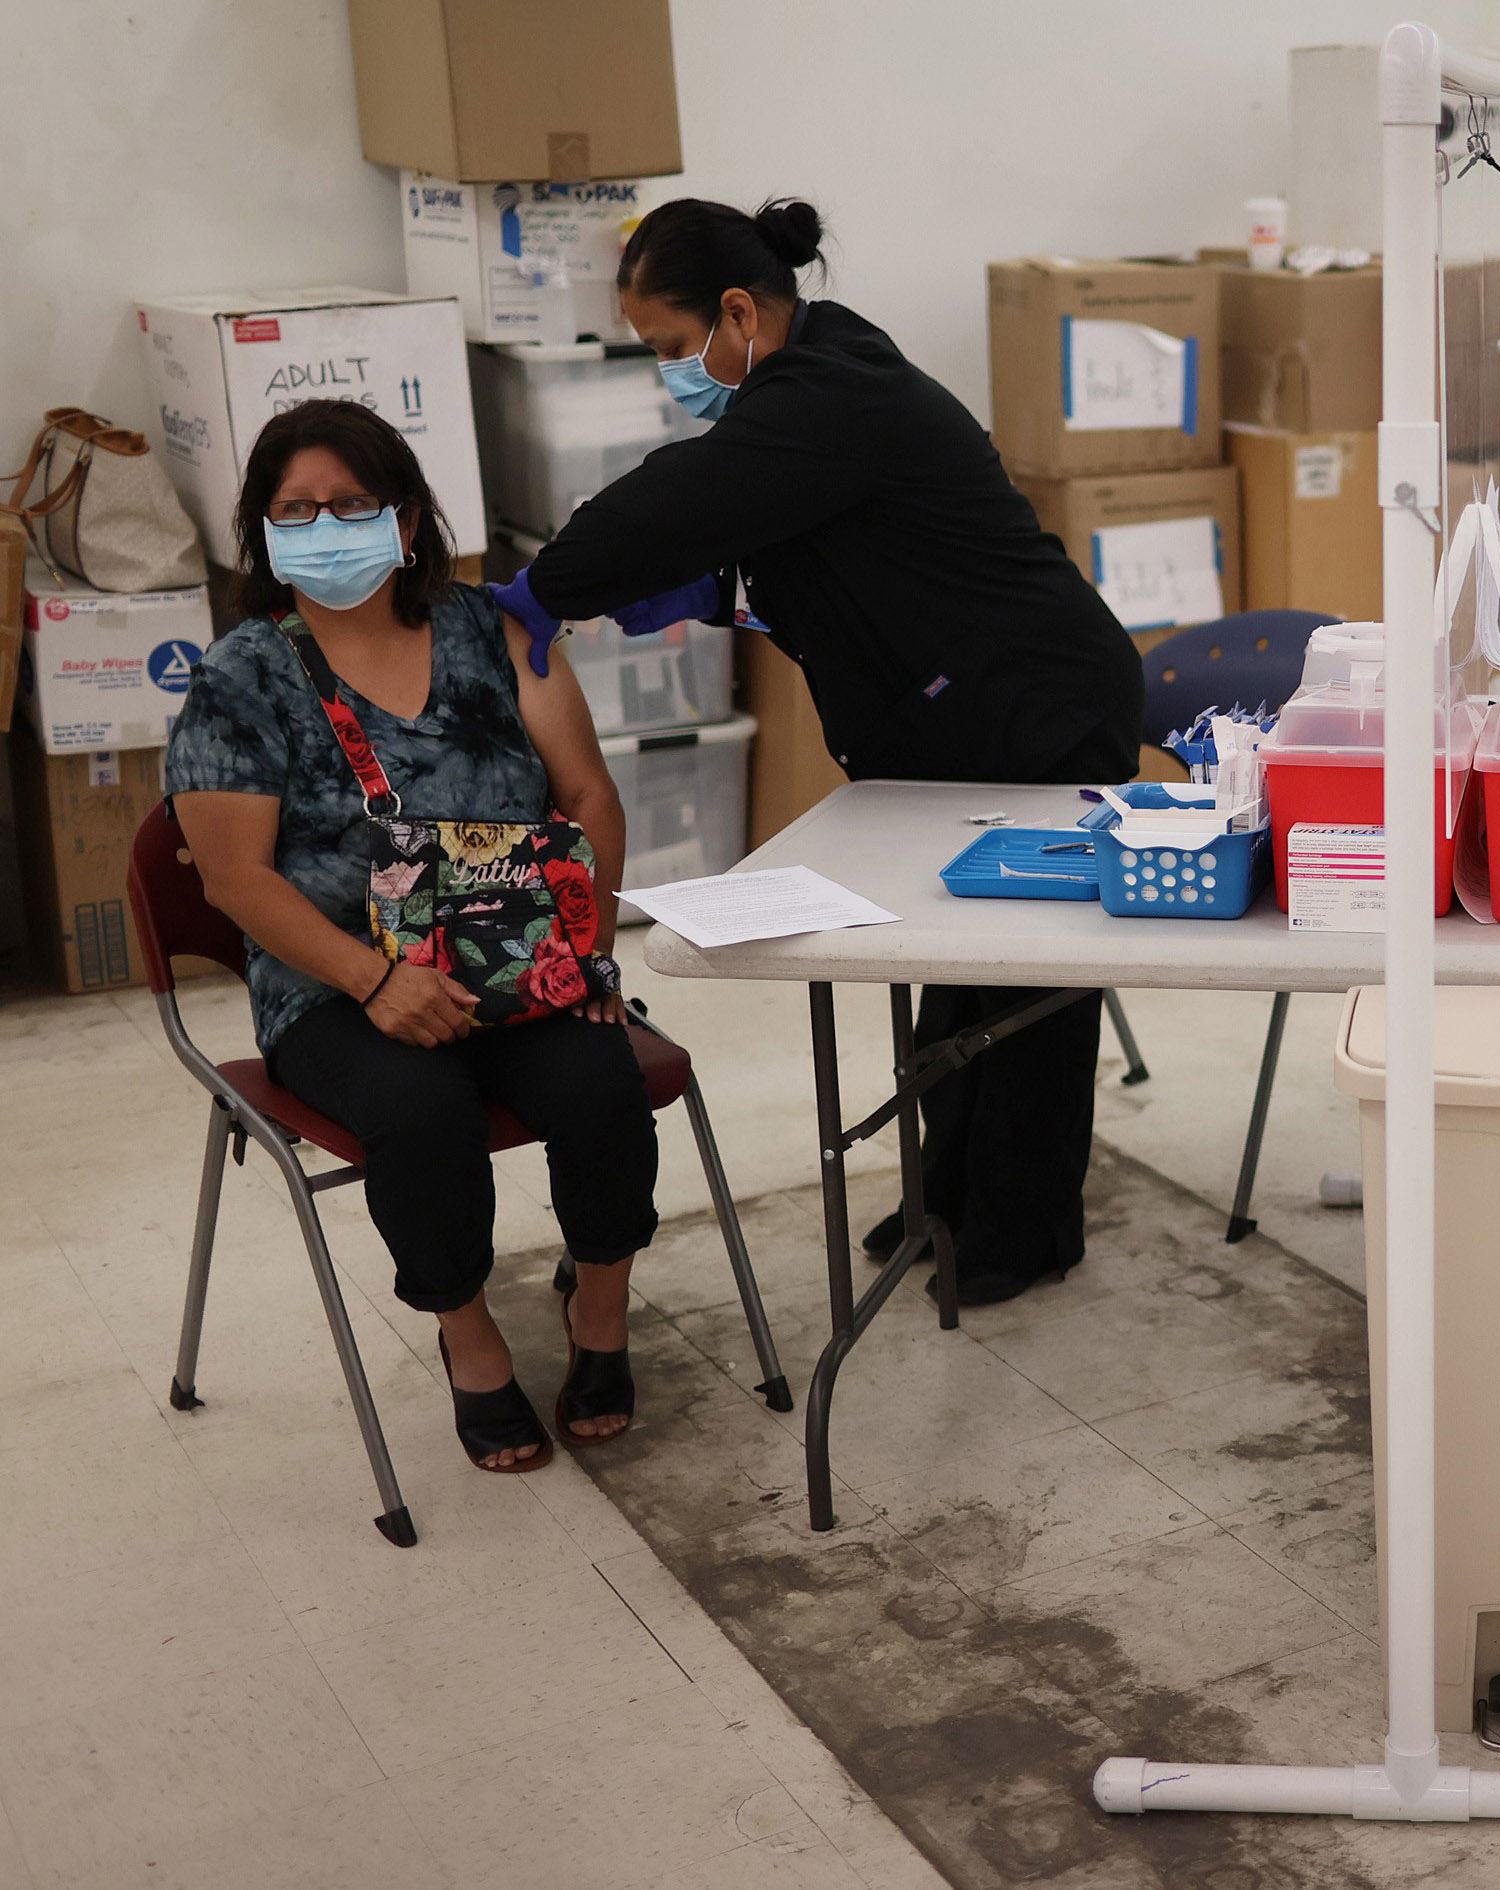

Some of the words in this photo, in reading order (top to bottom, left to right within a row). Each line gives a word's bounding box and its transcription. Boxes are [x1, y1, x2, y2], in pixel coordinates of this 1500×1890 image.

[265, 357, 370, 397] ADULT
[62, 659, 97, 671] Baby
[102, 658, 144, 670] Wipes
